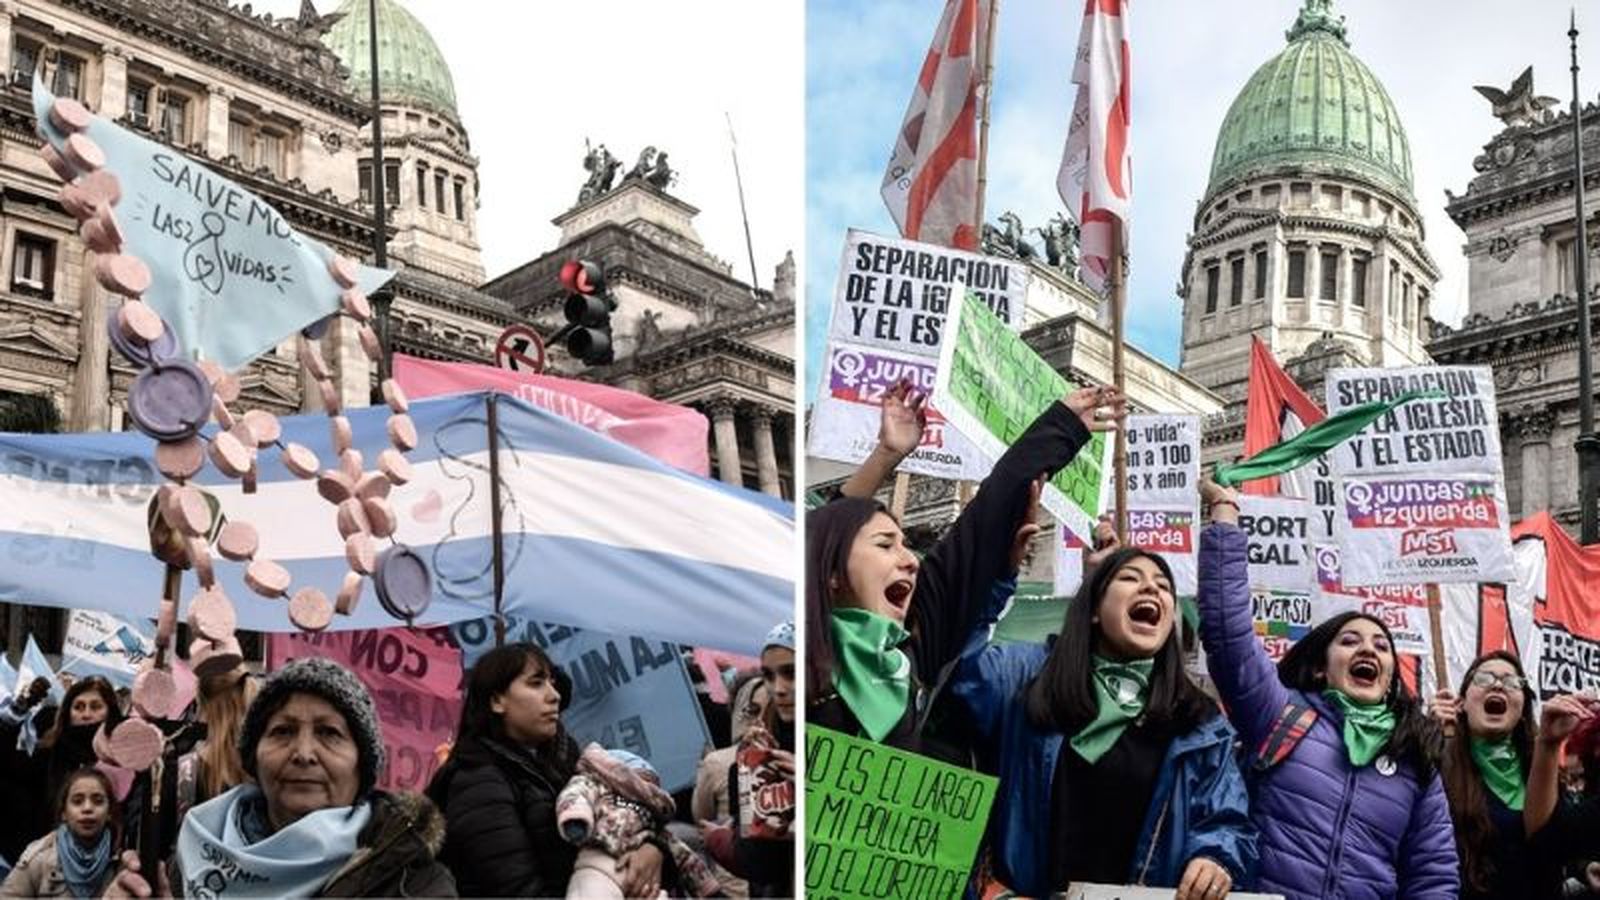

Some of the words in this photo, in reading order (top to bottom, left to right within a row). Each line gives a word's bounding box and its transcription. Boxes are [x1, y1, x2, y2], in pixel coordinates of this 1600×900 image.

[153, 153, 301, 246] SALVEMO
[856, 242, 1009, 291] SEPARACION
[846, 273, 878, 304] DE
[883, 278, 914, 310] LA
[851, 306, 868, 337] Y
[874, 309, 901, 342] EL
[910, 314, 947, 347] ES
[1337, 370, 1478, 407] SEPARACION
[1404, 398, 1489, 431] IGLESIA
[1144, 450, 1156, 467] a
[1161, 443, 1191, 466] 100
[1349, 440, 1364, 468] Y
[1371, 436, 1399, 466] EL
[1403, 428, 1488, 463] ESTADO
[1157, 466, 1187, 489] año
[1374, 500, 1489, 529] izquierda
[1403, 530, 1457, 554] MST
[836, 744, 875, 796] ES
[911, 766, 985, 822] LARGO
[830, 848, 858, 894] EL
